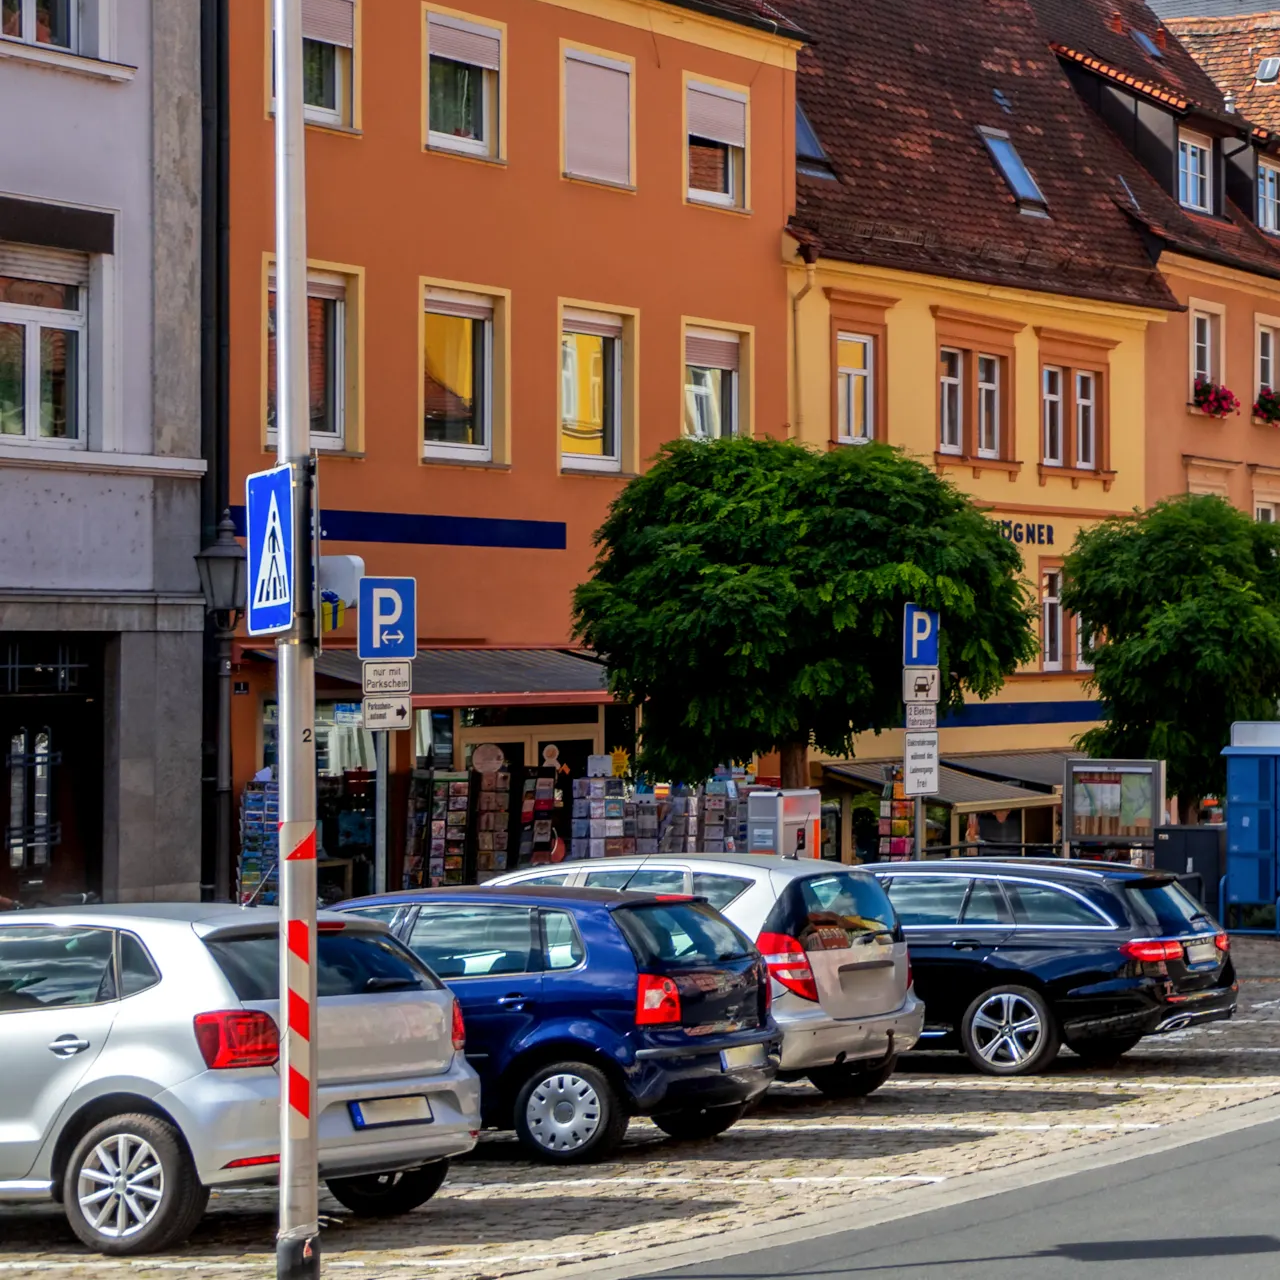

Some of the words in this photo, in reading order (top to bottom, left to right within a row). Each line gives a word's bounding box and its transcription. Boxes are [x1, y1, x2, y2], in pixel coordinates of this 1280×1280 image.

[372, 587, 403, 649] P
[912, 611, 932, 659] P
[373, 668, 386, 676] nur
[388, 666, 401, 676] mit
[366, 678, 408, 689] Parkschein
[367, 702, 394, 711] Parkschein-
[914, 706, 935, 716] Elektro-
[909, 718, 935, 728] fahrzeuge
[302, 728, 312, 743] 2
[916, 779, 928, 788] frei
